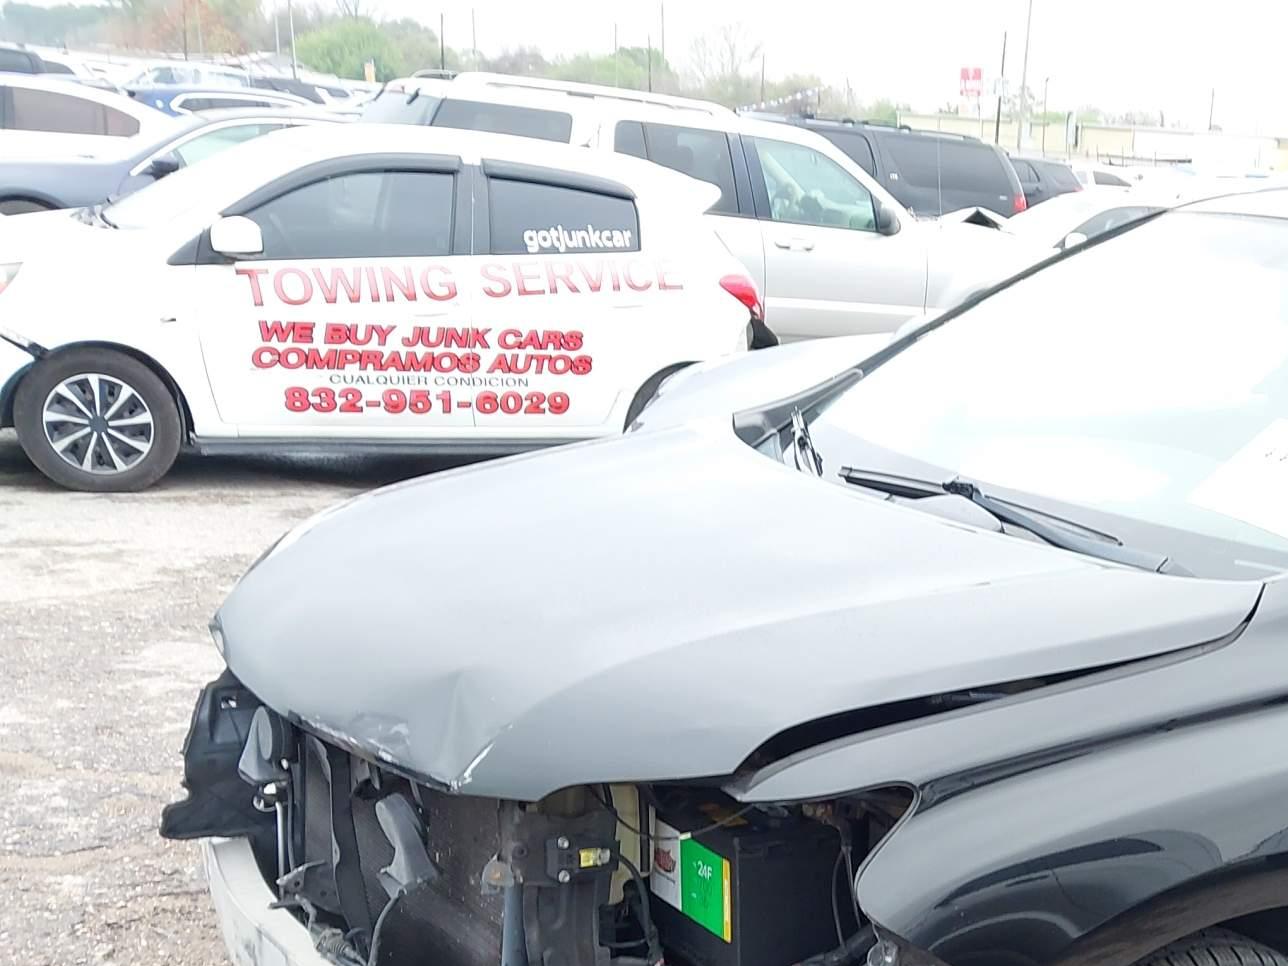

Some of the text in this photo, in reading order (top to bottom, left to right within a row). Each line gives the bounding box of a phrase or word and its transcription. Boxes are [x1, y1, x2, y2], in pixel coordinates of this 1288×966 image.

[235, 258, 684, 307] TOWING SERVICE
[258, 320, 584, 351] WE BUY JUNK CARS
[251, 346, 593, 376] COMPRAMOS AUTOS
[329, 373, 529, 388] CUALQUIER CONDICION
[284, 386, 570, 415] 832-951-6029
